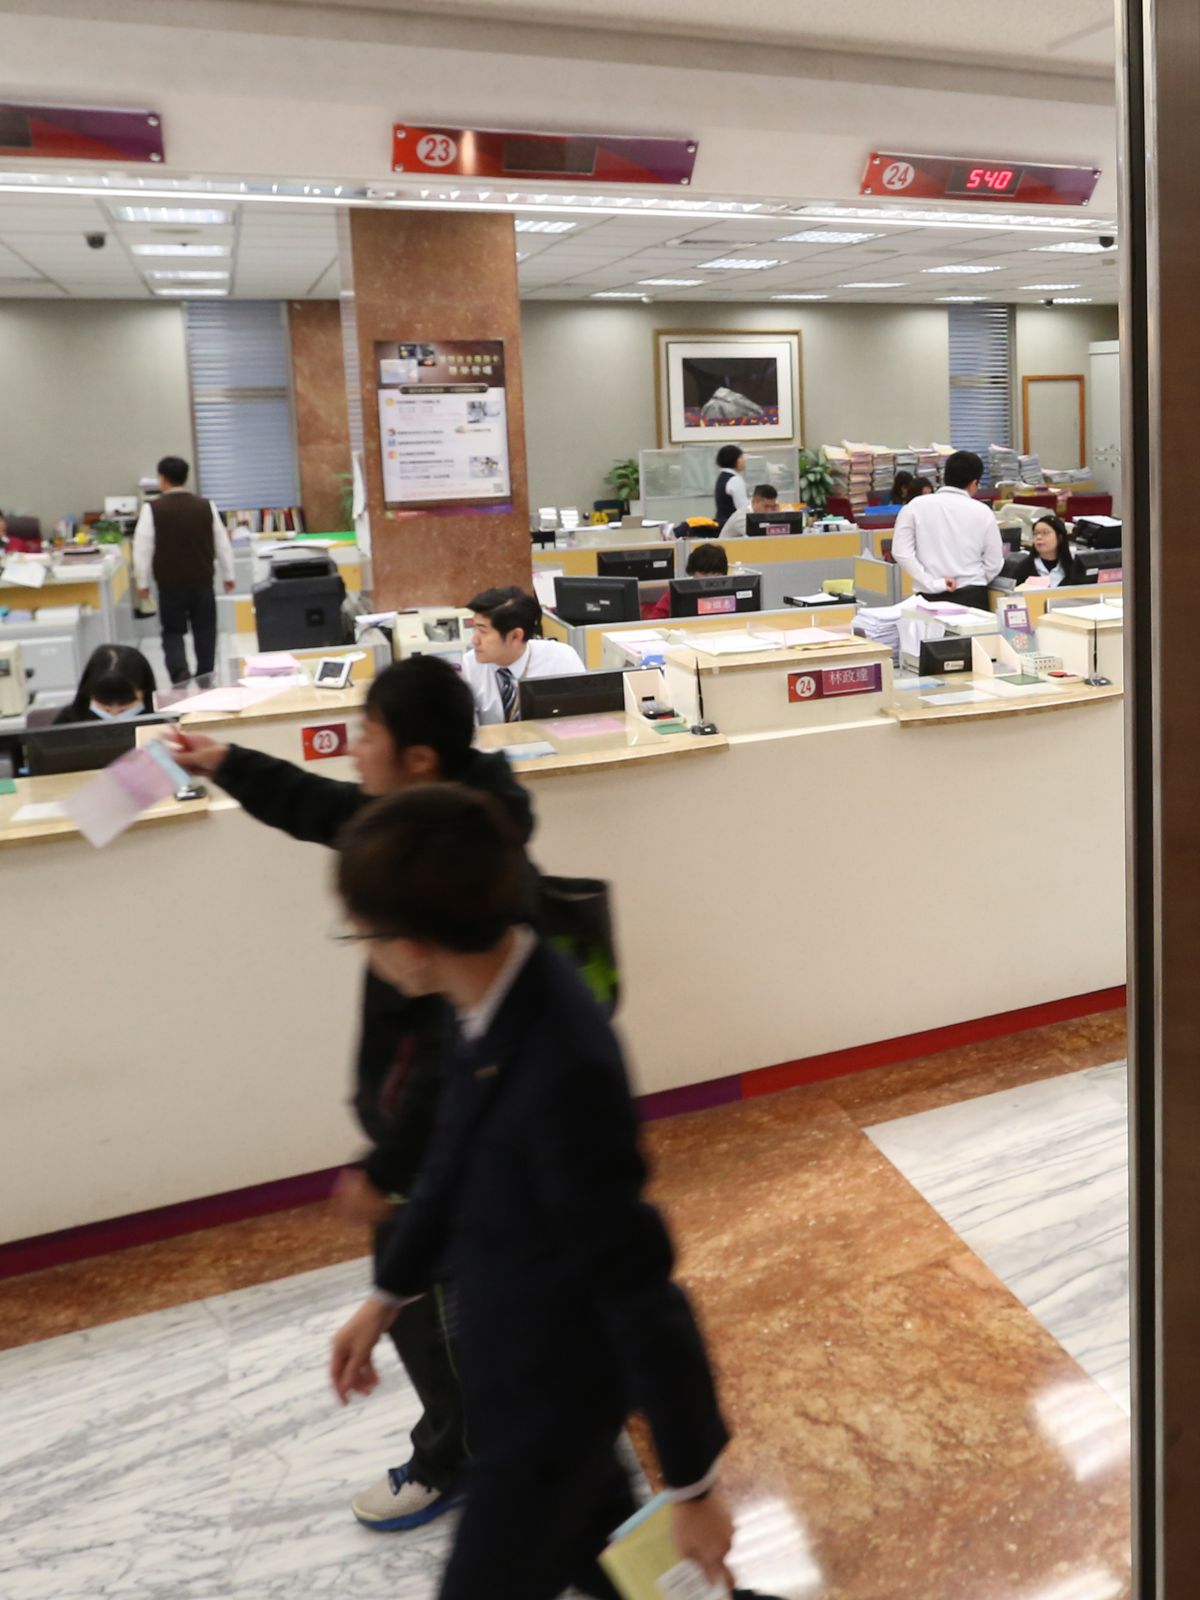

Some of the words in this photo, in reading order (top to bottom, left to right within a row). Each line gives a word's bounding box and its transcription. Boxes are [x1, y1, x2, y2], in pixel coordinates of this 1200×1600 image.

[423, 138, 450, 162] 23
[886, 167, 909, 187] 24
[966, 168, 1014, 191] 540
[800, 679, 812, 694] 24
[318, 732, 333, 750] 23
